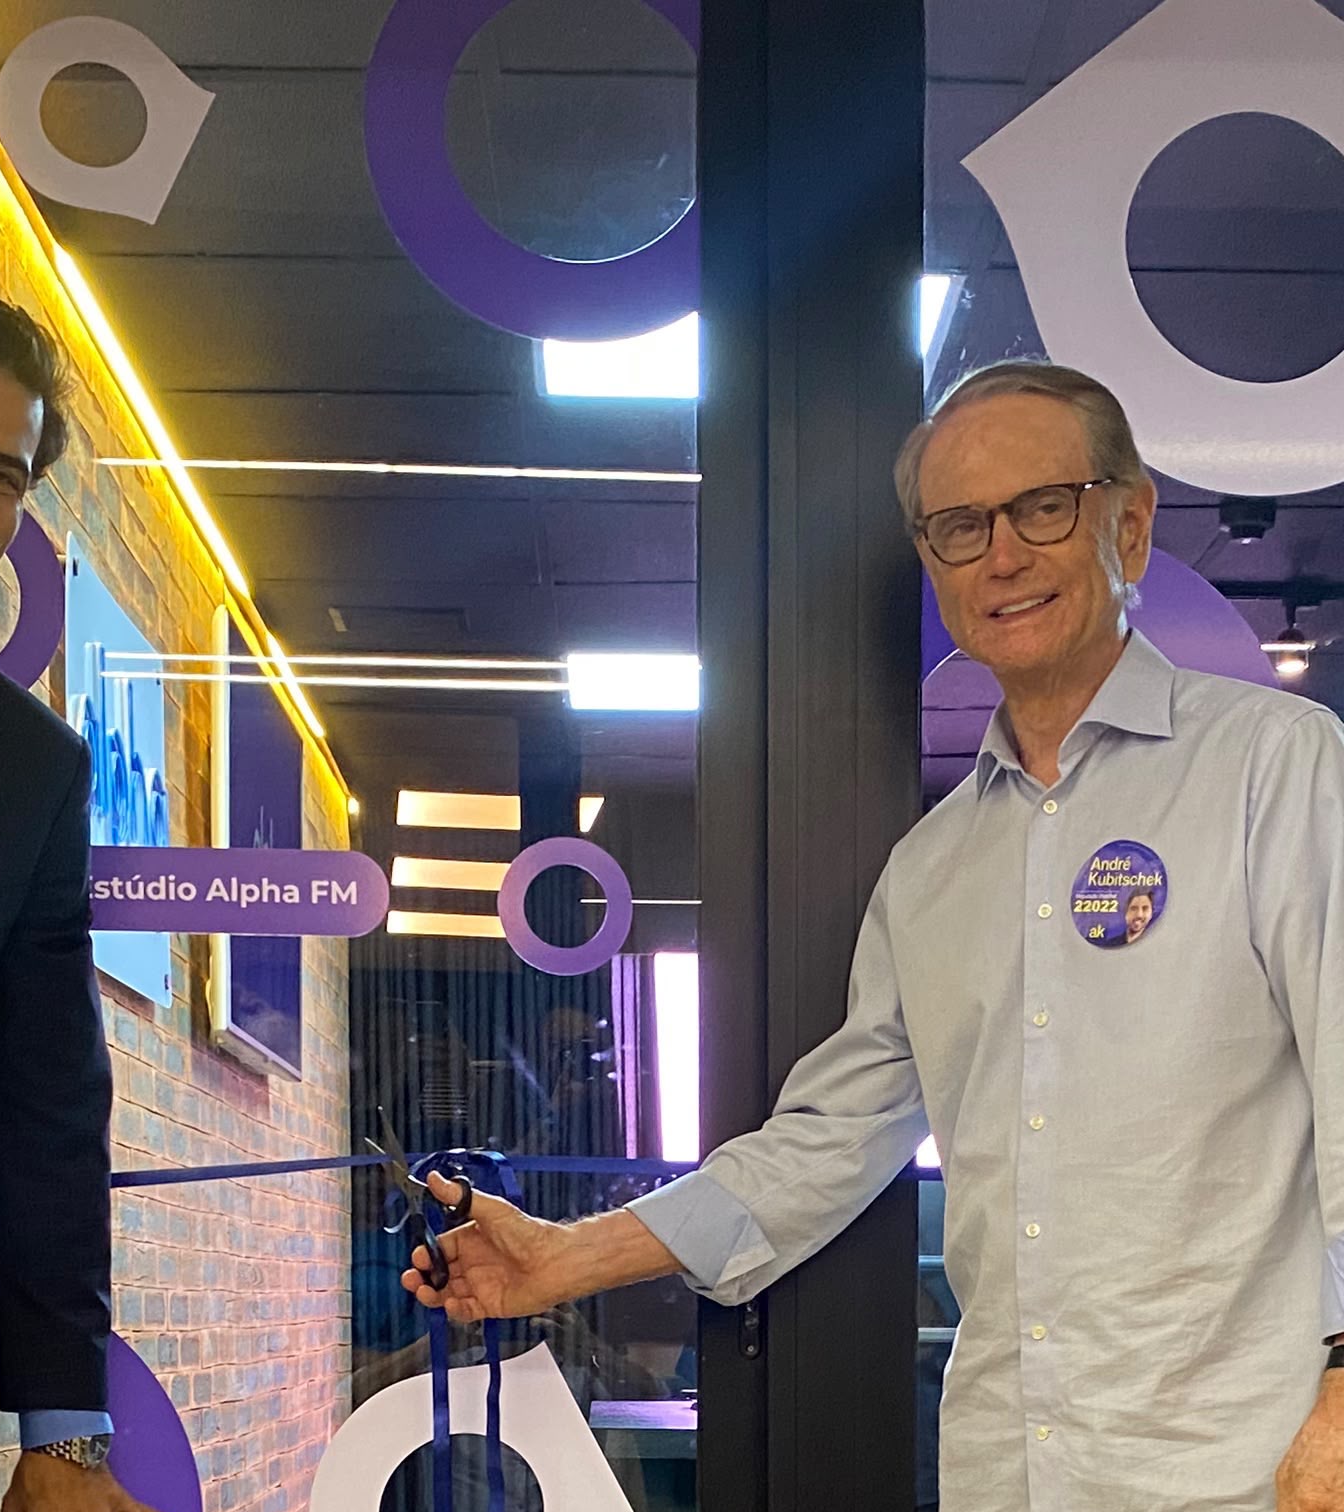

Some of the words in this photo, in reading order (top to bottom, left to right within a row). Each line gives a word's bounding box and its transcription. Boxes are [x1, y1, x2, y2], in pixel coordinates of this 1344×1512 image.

[1090, 856, 1131, 871] André
[1088, 871, 1163, 887] Kubitschek
[89, 874, 197, 901] stúdio
[205, 877, 299, 908] Alpha
[311, 880, 357, 904] FM
[1073, 900, 1119, 913] 22022
[1088, 923, 1106, 938] ak
